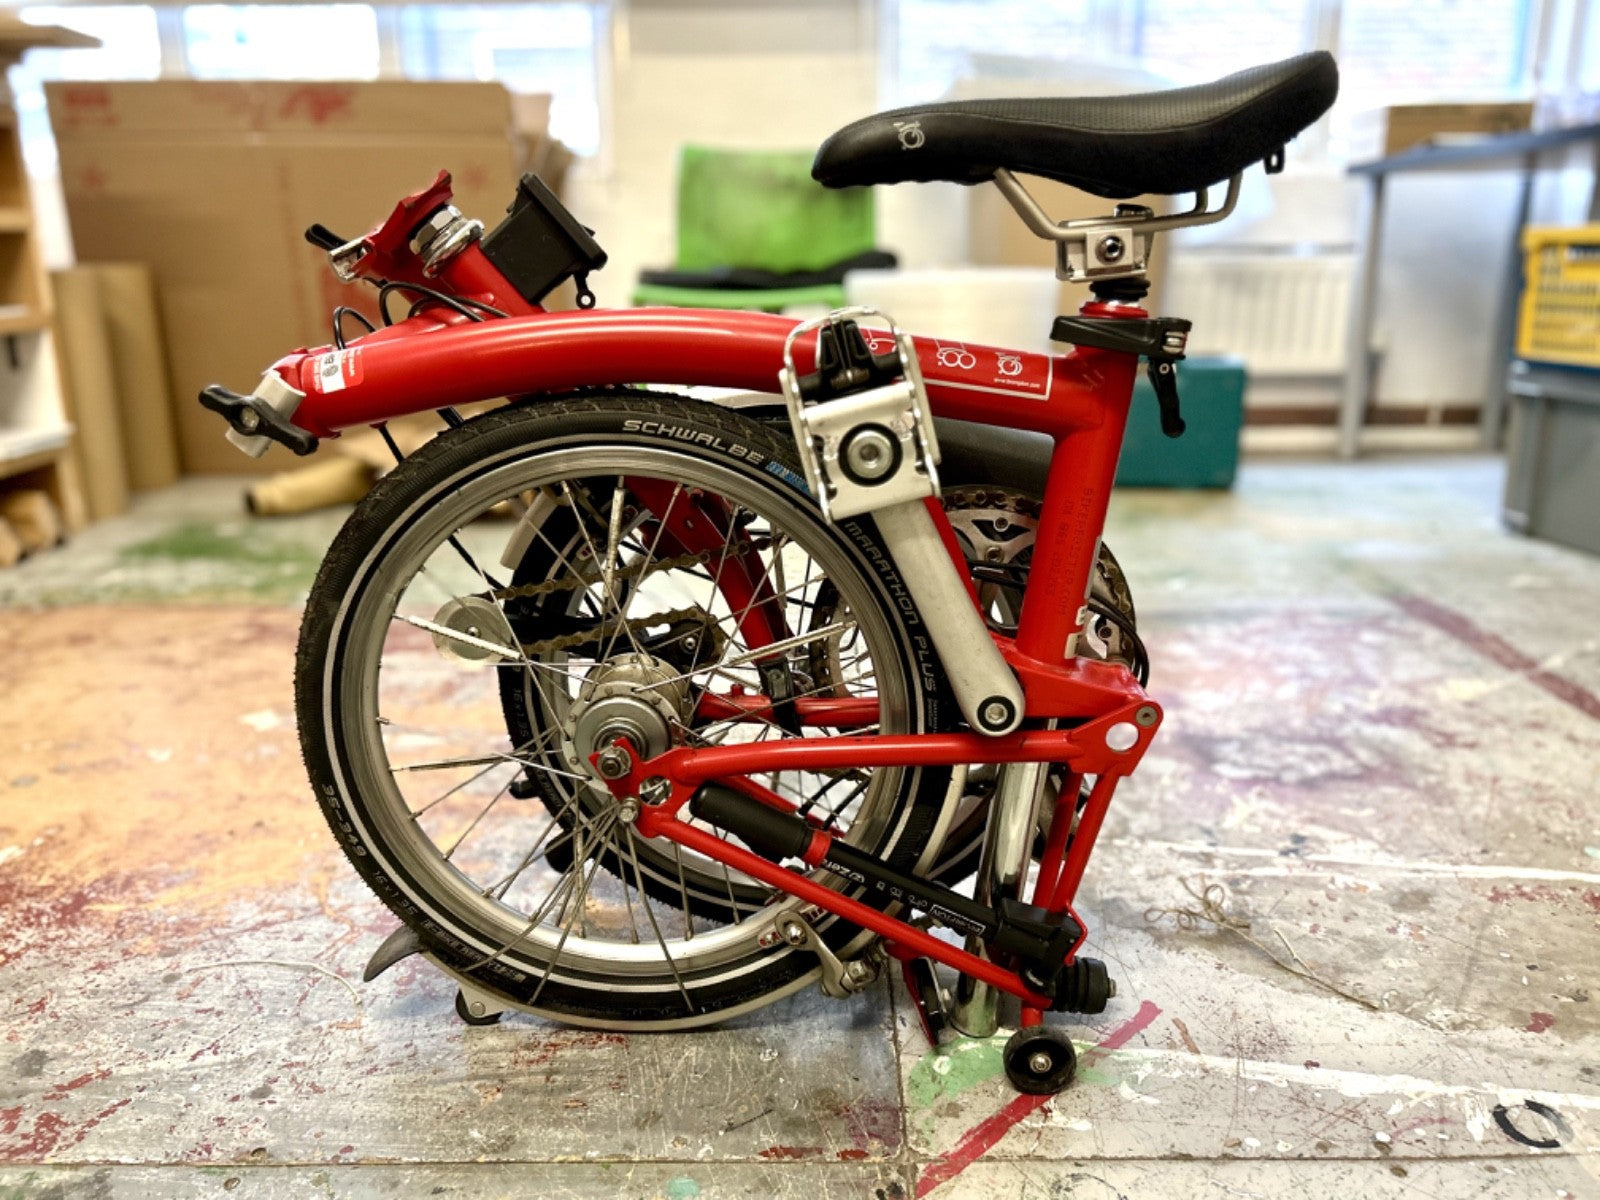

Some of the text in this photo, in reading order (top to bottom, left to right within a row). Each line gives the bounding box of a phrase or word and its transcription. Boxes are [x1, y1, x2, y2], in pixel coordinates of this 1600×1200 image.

[623, 420, 764, 465] SCHWALBE
[845, 521, 936, 692] MARATHON PLUS
[321, 784, 368, 857] 35-349
